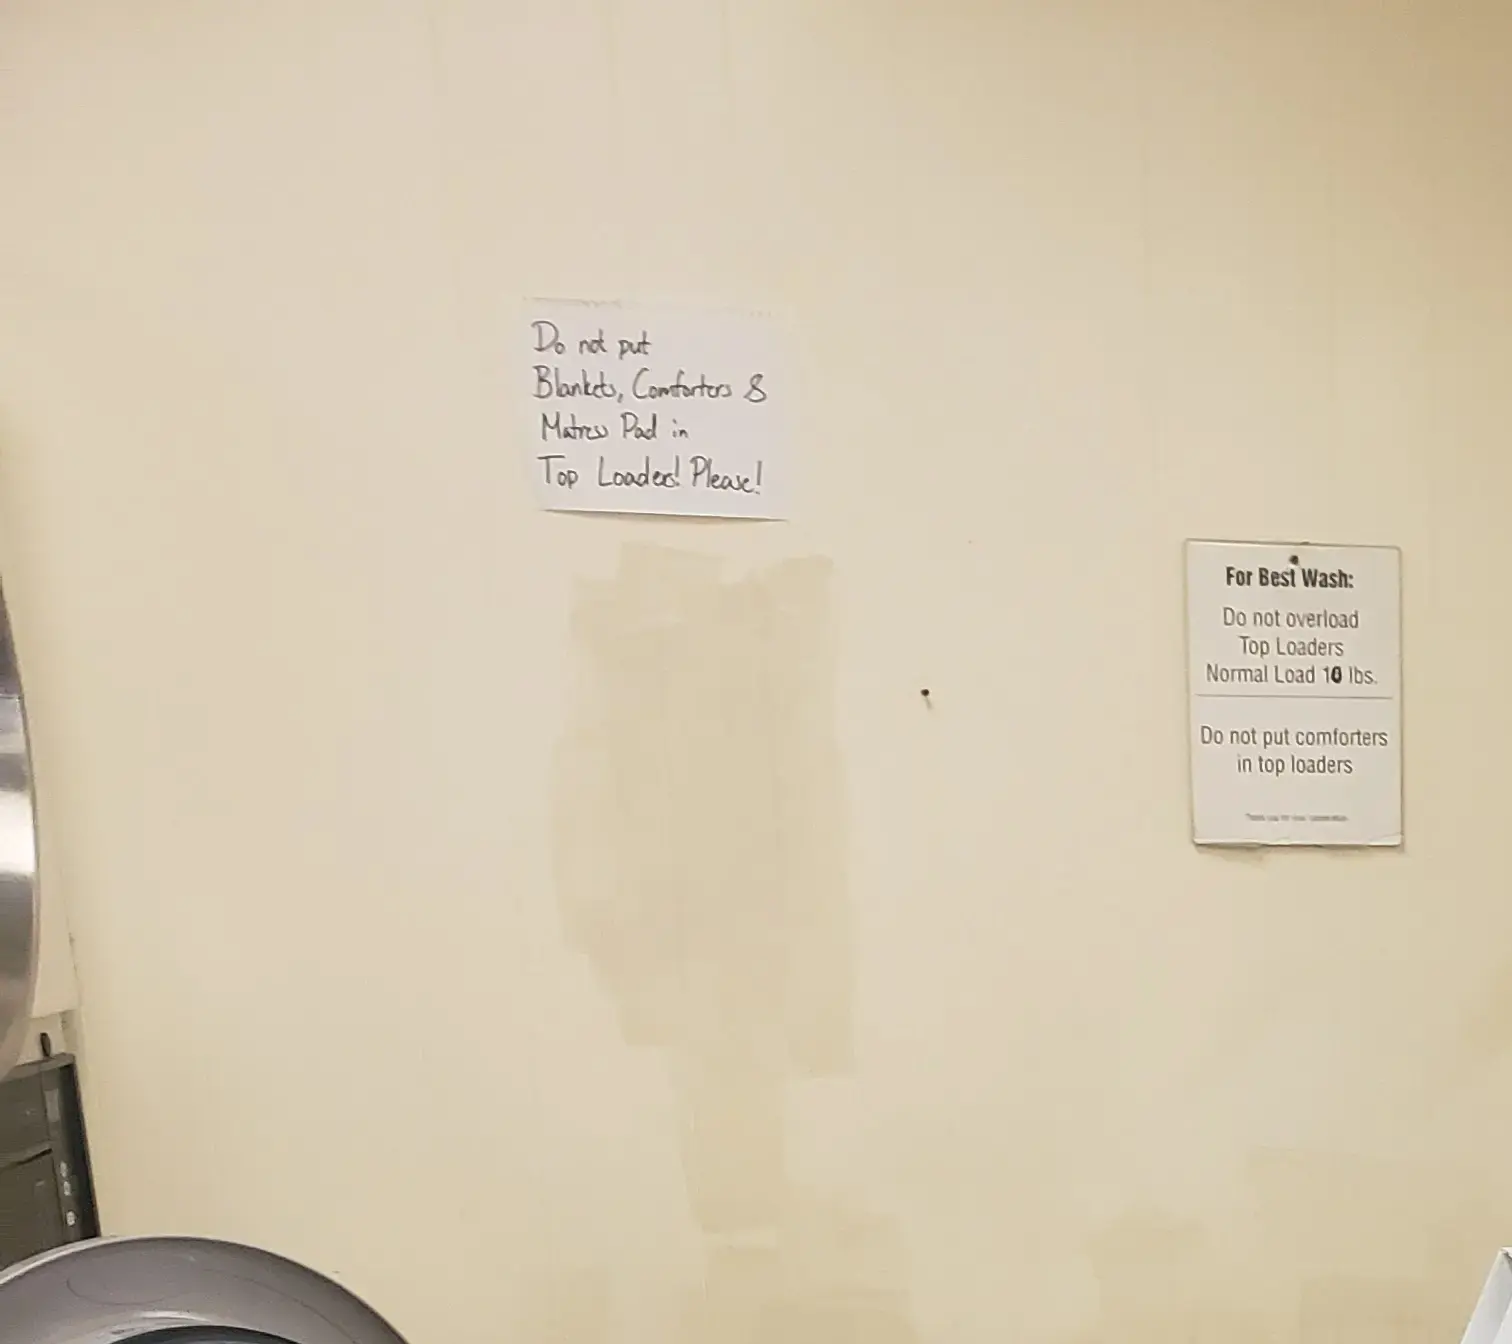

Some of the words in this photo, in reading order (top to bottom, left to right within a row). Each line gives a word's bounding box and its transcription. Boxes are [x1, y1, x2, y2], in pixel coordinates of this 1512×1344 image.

[531, 319, 566, 355] Do
[579, 329, 607, 355] not
[618, 331, 652, 360] put
[532, 364, 624, 403] Blankets,
[632, 367, 733, 400] Comforters
[620, 411, 657, 440] Pad
[672, 418, 689, 439] in
[537, 454, 579, 489] Top
[690, 455, 763, 495] Please!
[1226, 566, 1253, 586] For
[1259, 567, 1296, 588] Best
[1302, 568, 1354, 589] Wash:
[1223, 607, 1247, 627] Do
[1253, 609, 1280, 628] not
[1286, 610, 1359, 629] overload
[1240, 636, 1270, 658] Top
[1277, 637, 1344, 657] Loaders
[1206, 664, 1268, 684] Normal
[1275, 665, 1315, 684] Load
[1322, 666, 1342, 684] 10
[1349, 666, 1378, 685] lbs.
[1200, 726, 1224, 745] Do
[1230, 727, 1257, 745] not
[1263, 728, 1290, 749] put
[1296, 728, 1388, 747] comforters
[1237, 755, 1252, 773] in
[1258, 755, 1285, 777] top
[1292, 755, 1353, 774] loaders
